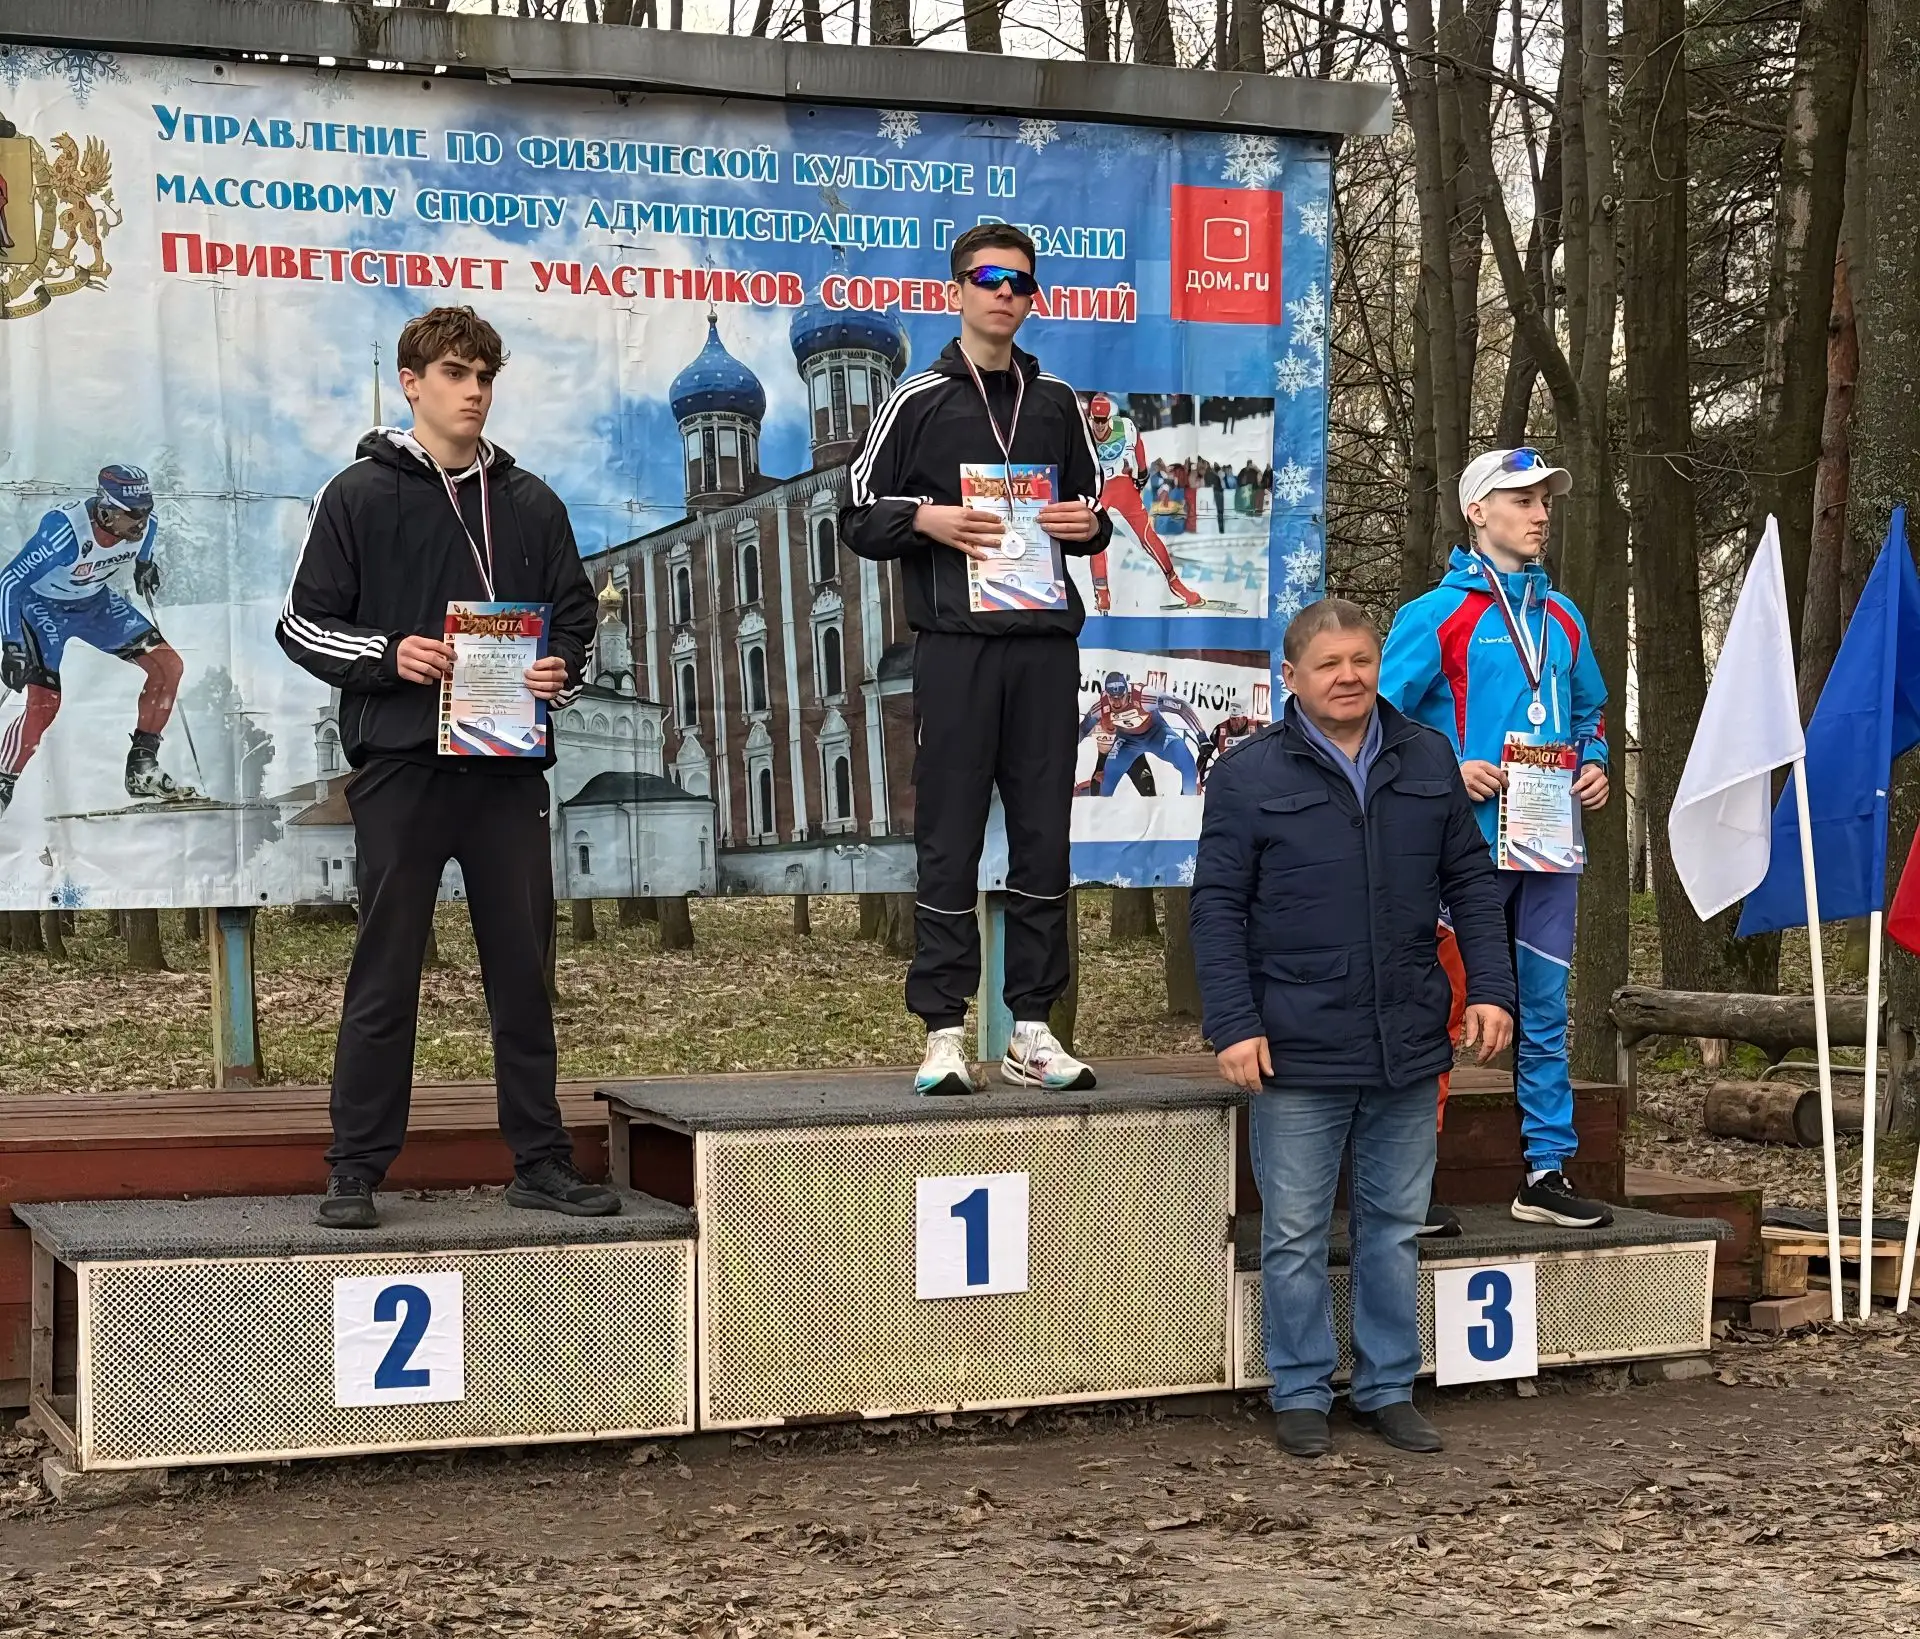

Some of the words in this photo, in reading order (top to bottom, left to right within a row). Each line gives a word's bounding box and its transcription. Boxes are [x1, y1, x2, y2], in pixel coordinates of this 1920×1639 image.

[445, 130, 502, 165] ПО
[517, 136, 778, 182] ФИЗИЧЕСКОЙ
[793, 152, 974, 196] КУЛЬТУРЕ
[987, 165, 1016, 198] И
[156, 172, 397, 217] МАССОВОМУ
[415, 188, 568, 228] СПОРТУ
[584, 201, 920, 250] АДМИНИСТРАЦИИ
[977, 214, 1126, 260] ЗАНИ
[529, 260, 804, 308] УЧАСТНИКОВ
[820, 274, 1138, 324] СОРЕВАНИЙ
[12, 544, 54, 579] LUKOIL
[950, 1188, 990, 1287] 1
[373, 1283, 432, 1390] 2
[1467, 1269, 1514, 1362] 3
